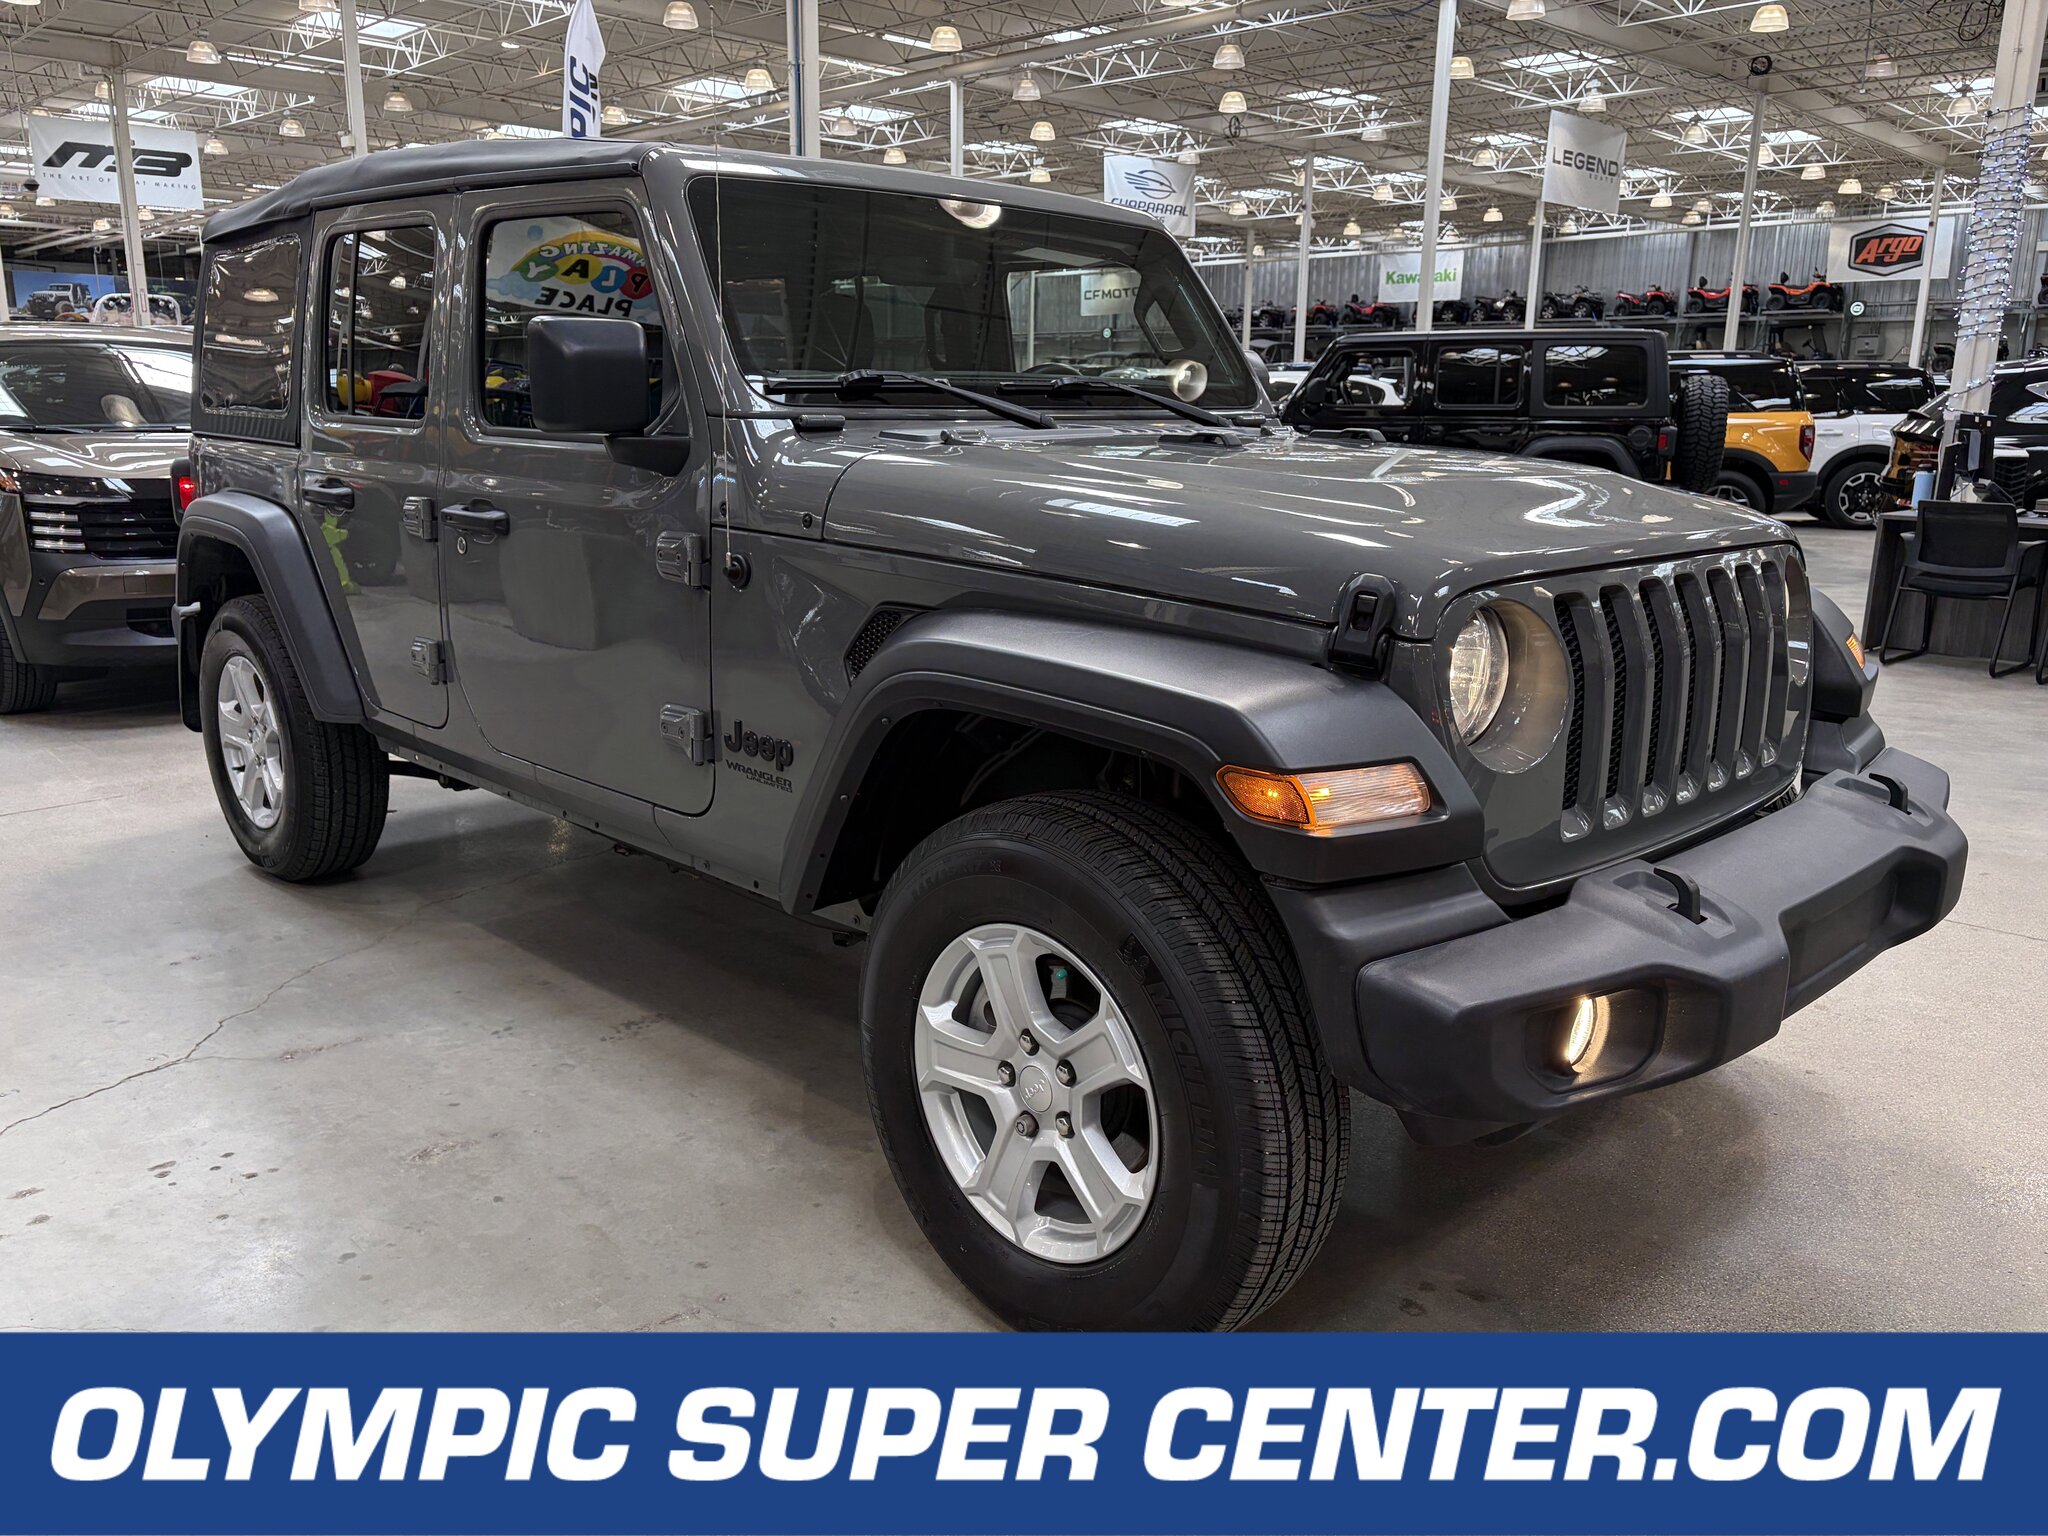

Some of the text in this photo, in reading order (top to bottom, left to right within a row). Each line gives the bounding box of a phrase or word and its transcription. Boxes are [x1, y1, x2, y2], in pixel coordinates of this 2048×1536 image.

[1552, 146, 1619, 177] LEGEND
[154, 182, 197, 190] MAKING
[1855, 236, 1923, 264] Argo
[1385, 267, 1457, 285] Kawaki
[723, 719, 794, 772] Jeep
[725, 759, 792, 788] WRANGLER
[746, 774, 793, 793] UNLIMITED
